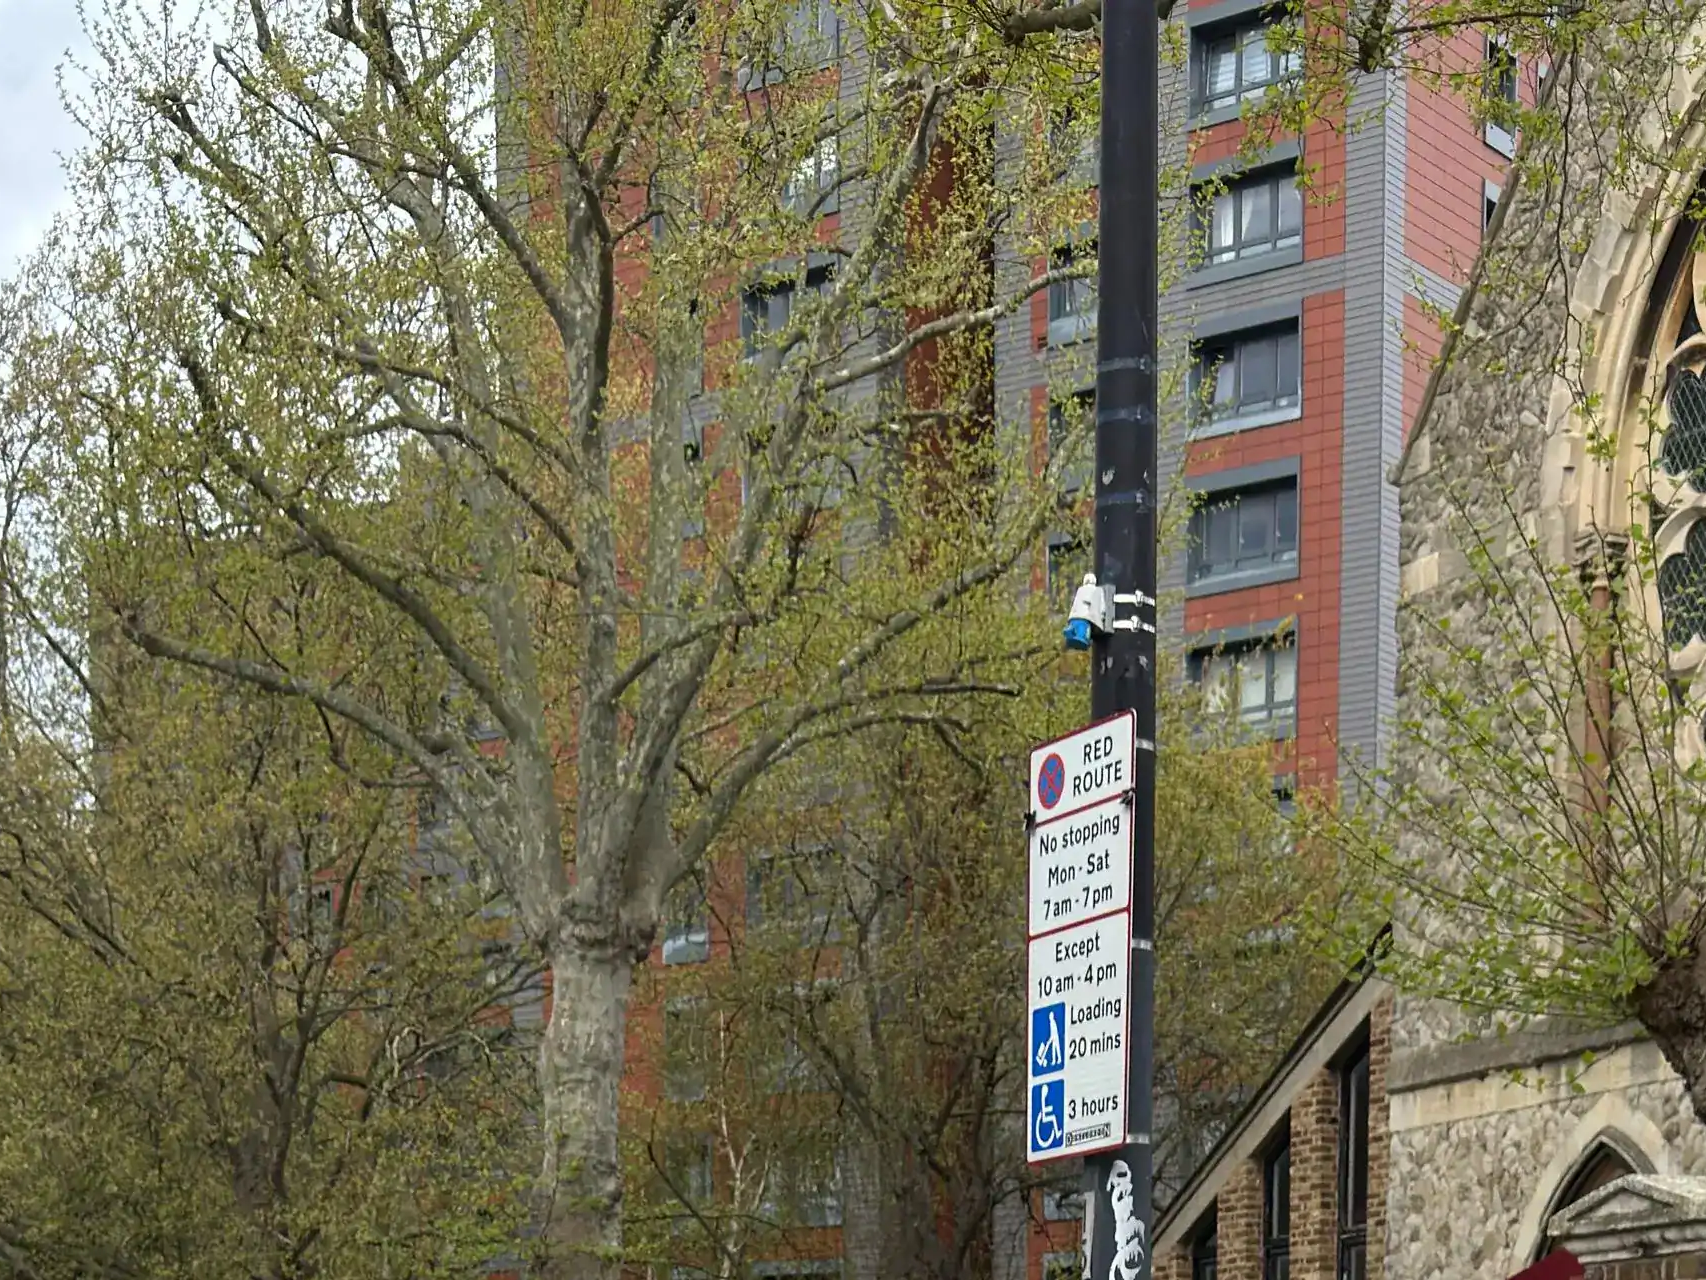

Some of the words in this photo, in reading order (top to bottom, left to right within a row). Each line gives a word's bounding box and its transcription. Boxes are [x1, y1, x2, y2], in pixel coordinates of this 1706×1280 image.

[1083, 735, 1113, 766] RED
[1072, 760, 1123, 798] ROUTE
[1039, 833, 1058, 857] No
[1062, 814, 1120, 849] stopping
[1048, 865, 1076, 888] Mon
[1087, 849, 1110, 876] Sat
[1055, 931, 1101, 962] Except
[1070, 997, 1122, 1025] Loading
[1069, 1036, 1087, 1060] 20
[1090, 1032, 1121, 1056] mins
[1068, 1100, 1077, 1120] 3
[1081, 1094, 1119, 1117] hours
